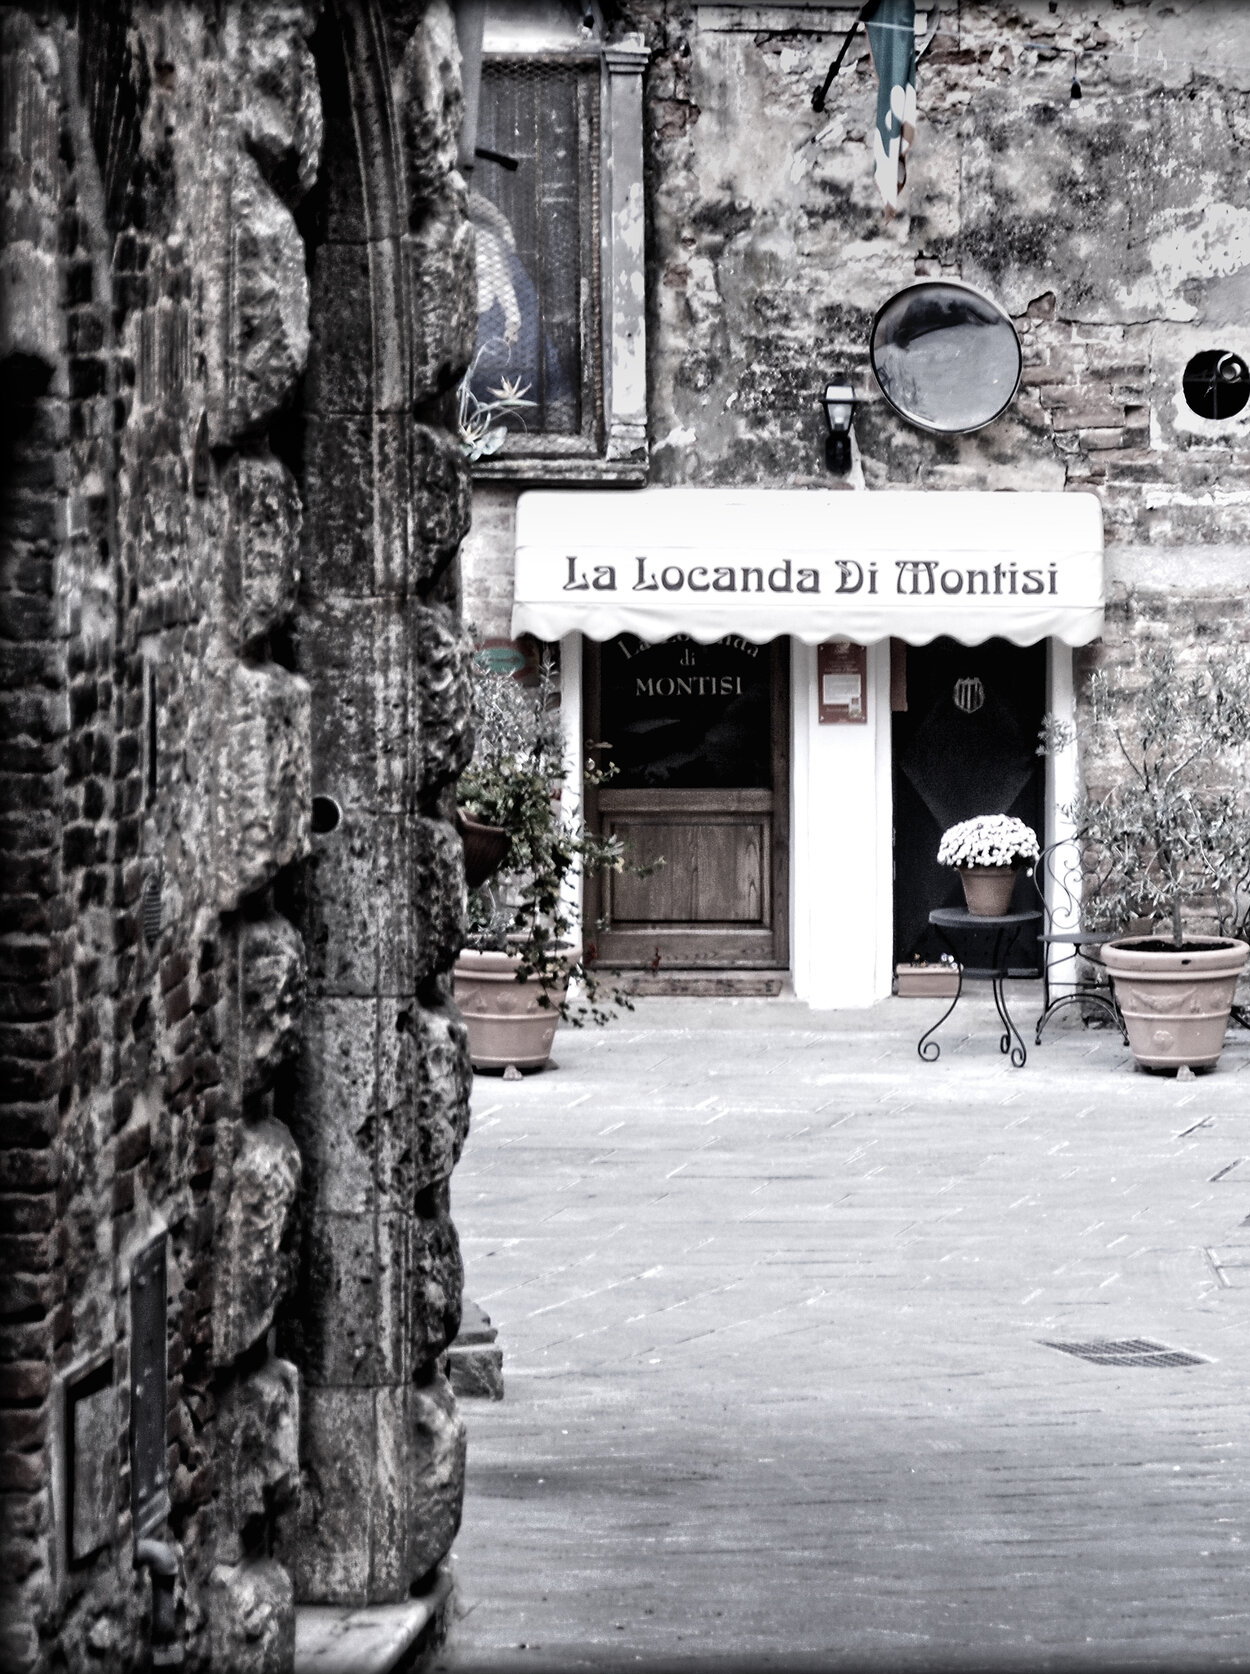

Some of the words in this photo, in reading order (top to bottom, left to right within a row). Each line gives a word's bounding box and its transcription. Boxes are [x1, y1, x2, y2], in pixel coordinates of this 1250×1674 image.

[562, 556, 617, 591] La
[632, 557, 821, 594] Locanda
[834, 559, 878, 595] Di
[895, 560, 1058, 595] Montisi
[679, 648, 695, 666] di
[636, 676, 743, 696] MONTISI
